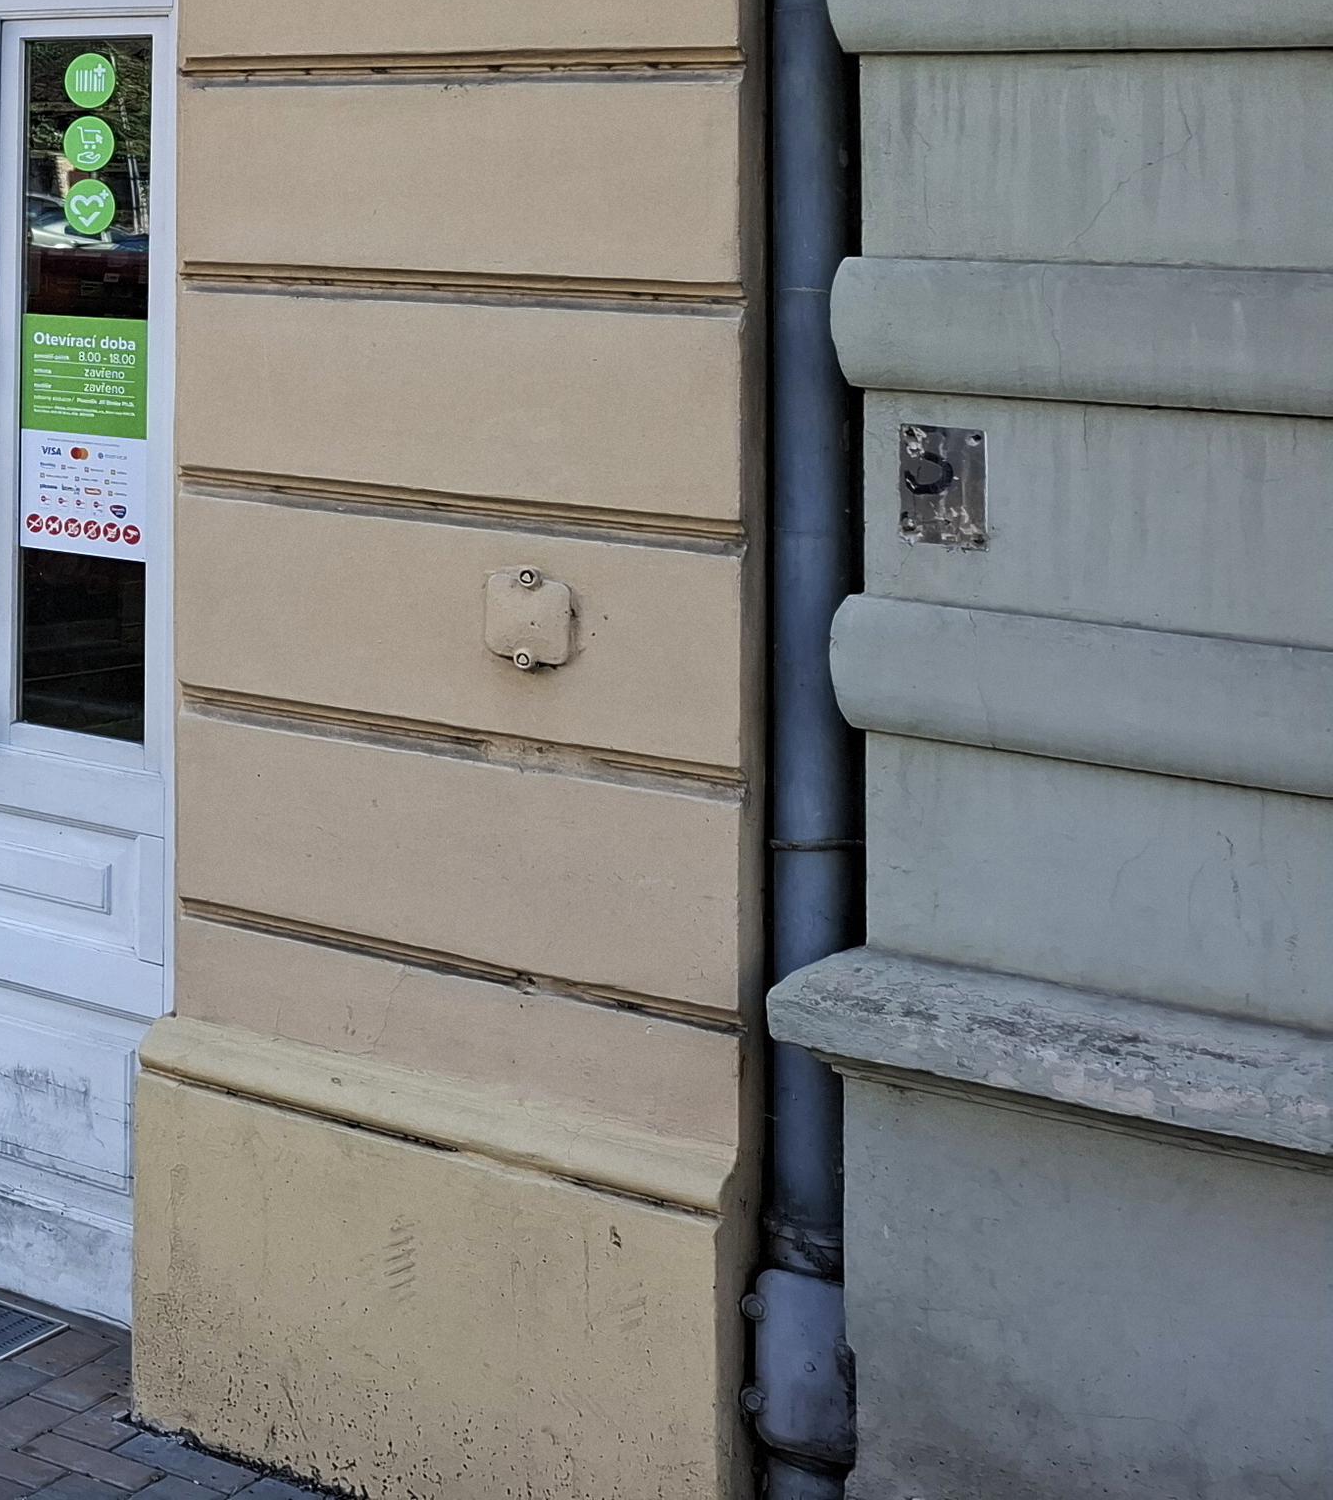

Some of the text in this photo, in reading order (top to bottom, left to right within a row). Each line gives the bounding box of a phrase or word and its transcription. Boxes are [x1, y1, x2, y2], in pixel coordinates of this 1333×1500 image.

[33, 332, 136, 350] Otevírací doba
[78, 352, 101, 362] 8.00
[109, 353, 136, 365] 18.00
[84, 368, 125, 380] zavřeno
[83, 382, 125, 395] zavřeno
[41, 446, 61, 456] VISA
